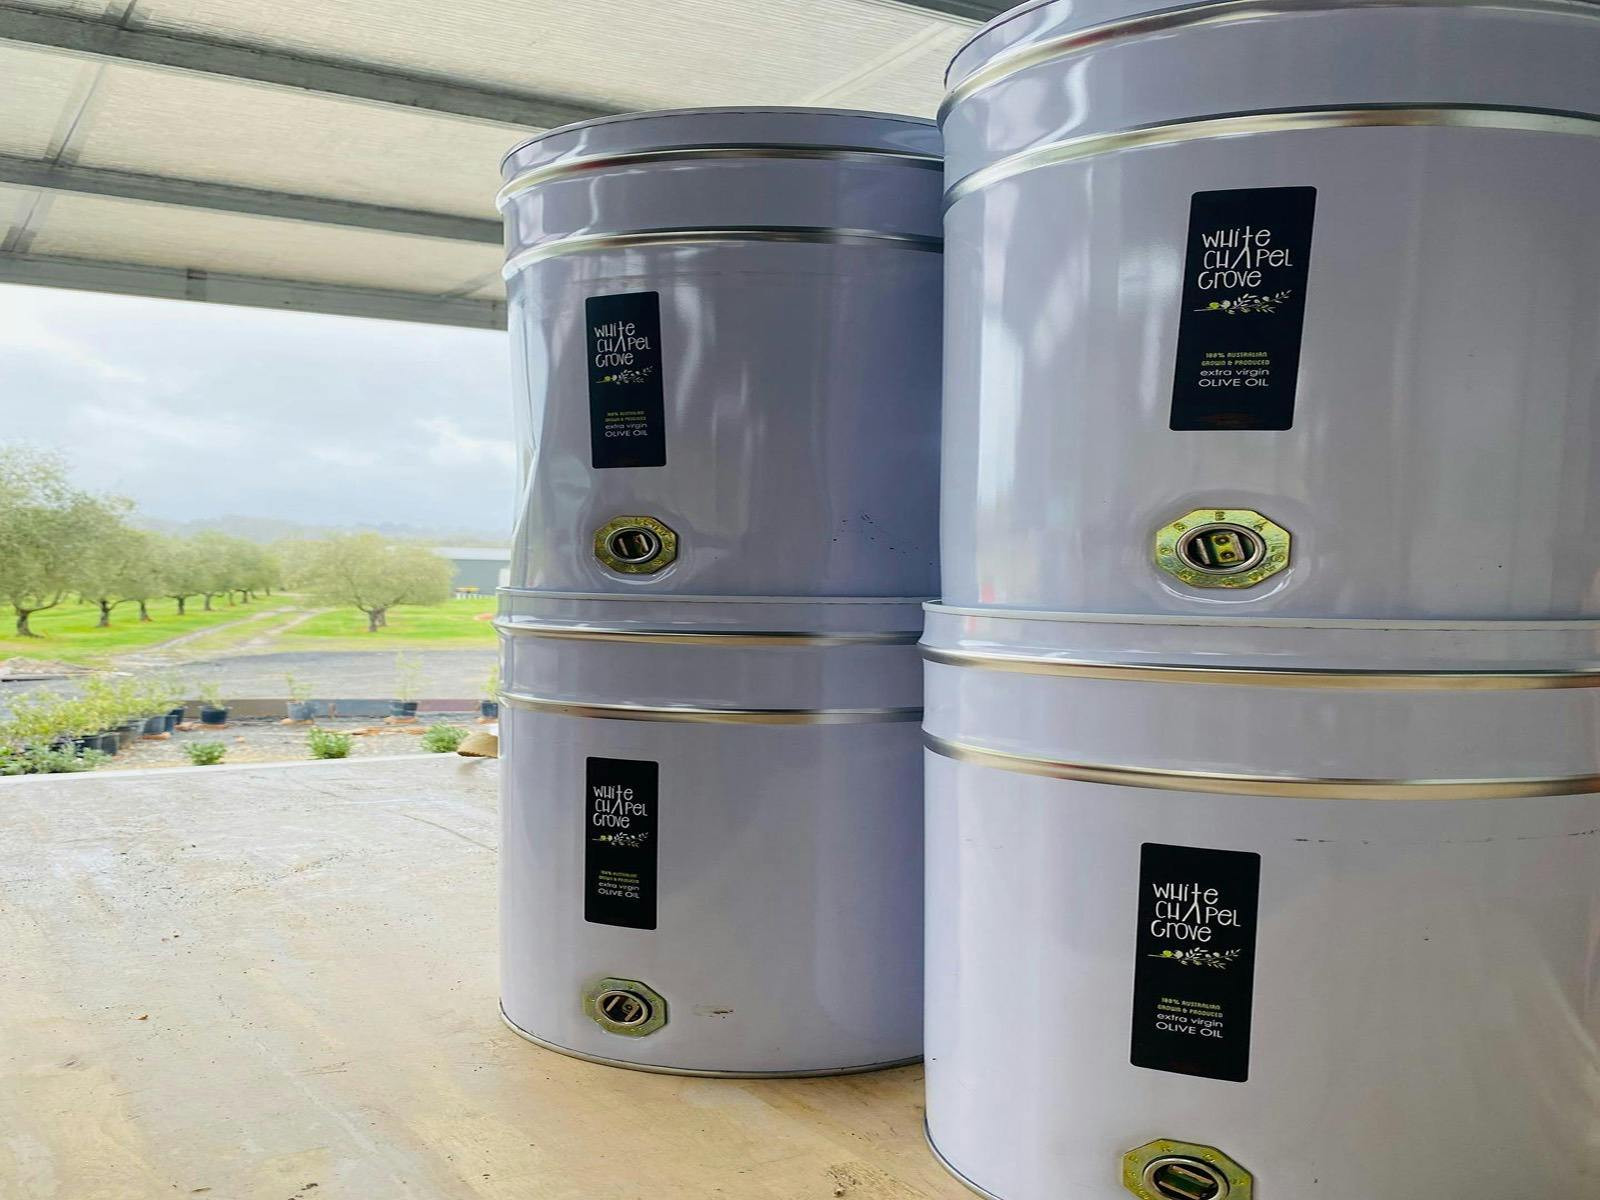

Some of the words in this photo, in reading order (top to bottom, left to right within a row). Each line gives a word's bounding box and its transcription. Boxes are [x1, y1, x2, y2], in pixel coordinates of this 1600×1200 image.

[1198, 270, 1262, 289] Grove
[595, 352, 634, 368] Grove
[1235, 368, 1270, 377] virgin
[1198, 378, 1241, 387] OLIVE
[1244, 378, 1270, 387] OIL
[593, 813, 630, 828] Grove
[598, 888, 623, 897] OLIVE
[1151, 920, 1212, 942] Grove
[1156, 1013, 1188, 1023] extra
[1190, 1017, 1224, 1028] virgin
[1155, 1021, 1197, 1035] OLIVE
[1200, 1028, 1224, 1039] OIL
